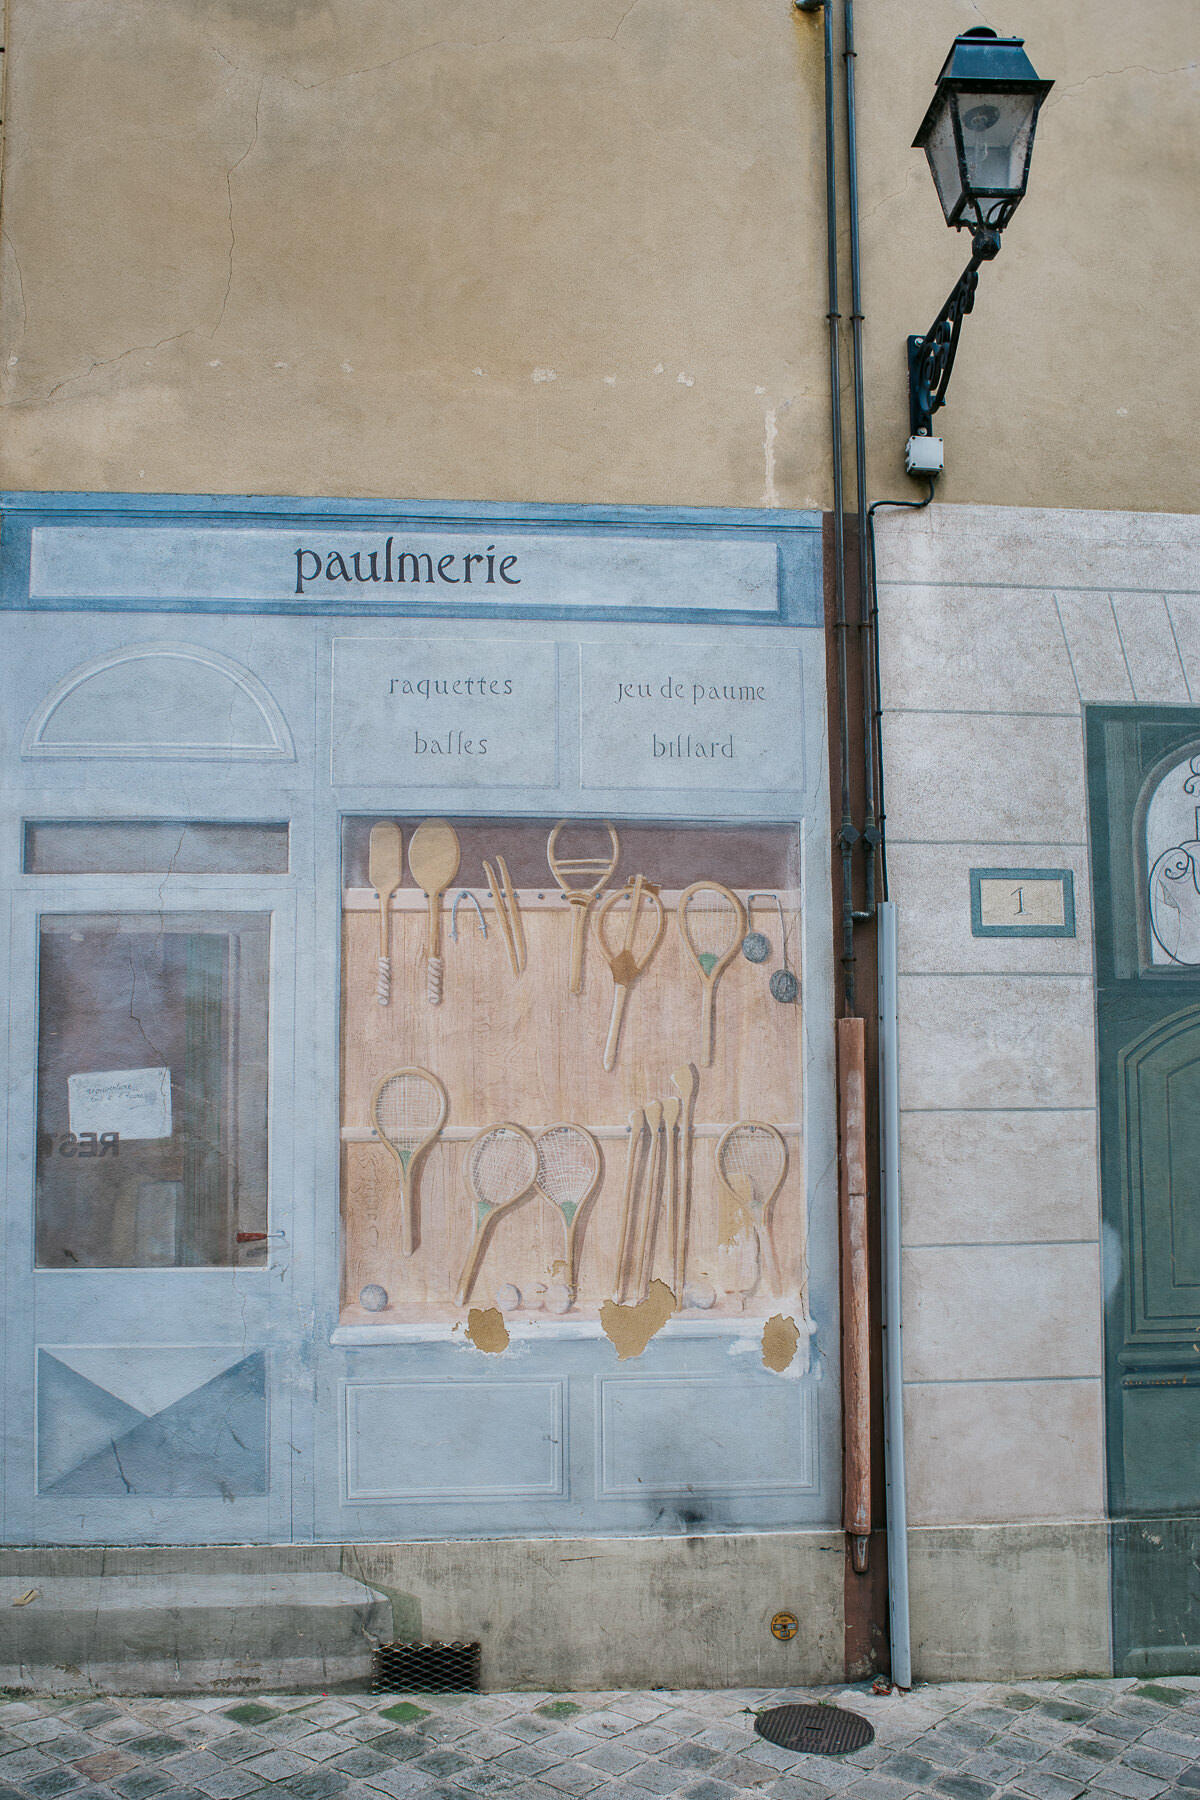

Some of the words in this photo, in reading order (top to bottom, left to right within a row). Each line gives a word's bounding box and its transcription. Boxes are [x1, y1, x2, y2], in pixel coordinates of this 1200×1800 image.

[293, 536, 522, 594] paulmerie
[389, 676, 513, 701] raquettes
[615, 682, 652, 704] jeu
[661, 677, 685, 699] de
[693, 683, 766, 706] paume
[414, 731, 488, 755] balles
[652, 734, 734, 760] billard
[1009, 886, 1032, 916] 1
